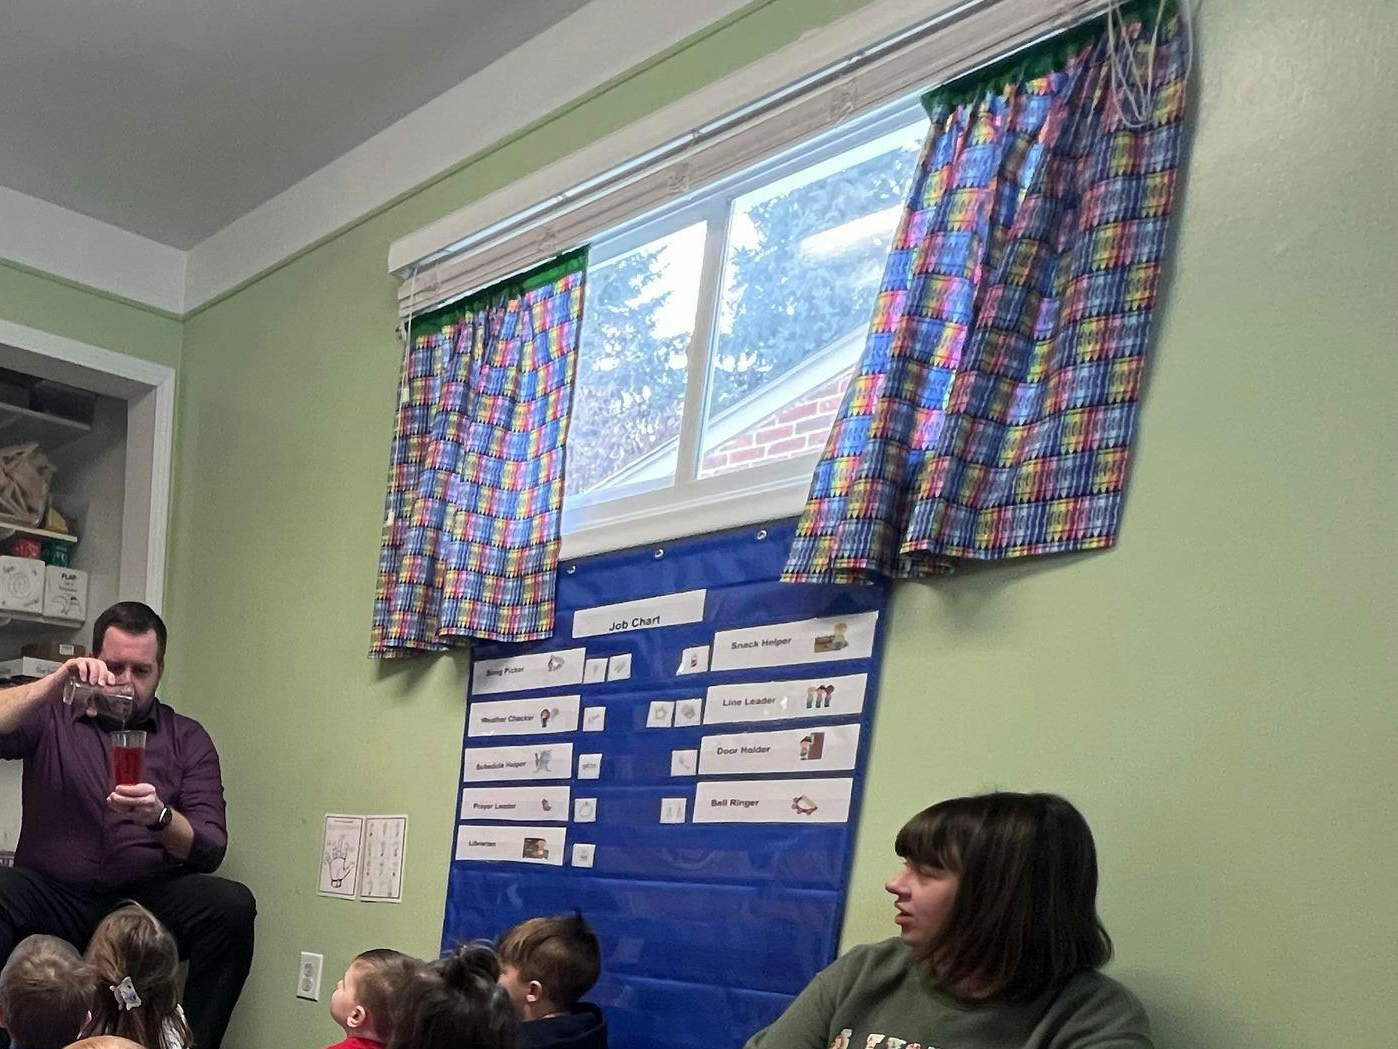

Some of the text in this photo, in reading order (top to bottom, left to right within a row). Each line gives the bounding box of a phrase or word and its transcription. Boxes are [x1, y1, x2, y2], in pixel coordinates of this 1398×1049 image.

[609, 615, 661, 632] Job Chart
[731, 637, 792, 650] Snack Helper
[722, 696, 776, 706] Line Leader
[716, 745, 771, 755] Door Holder
[711, 798, 759, 808] Bell Ringer
